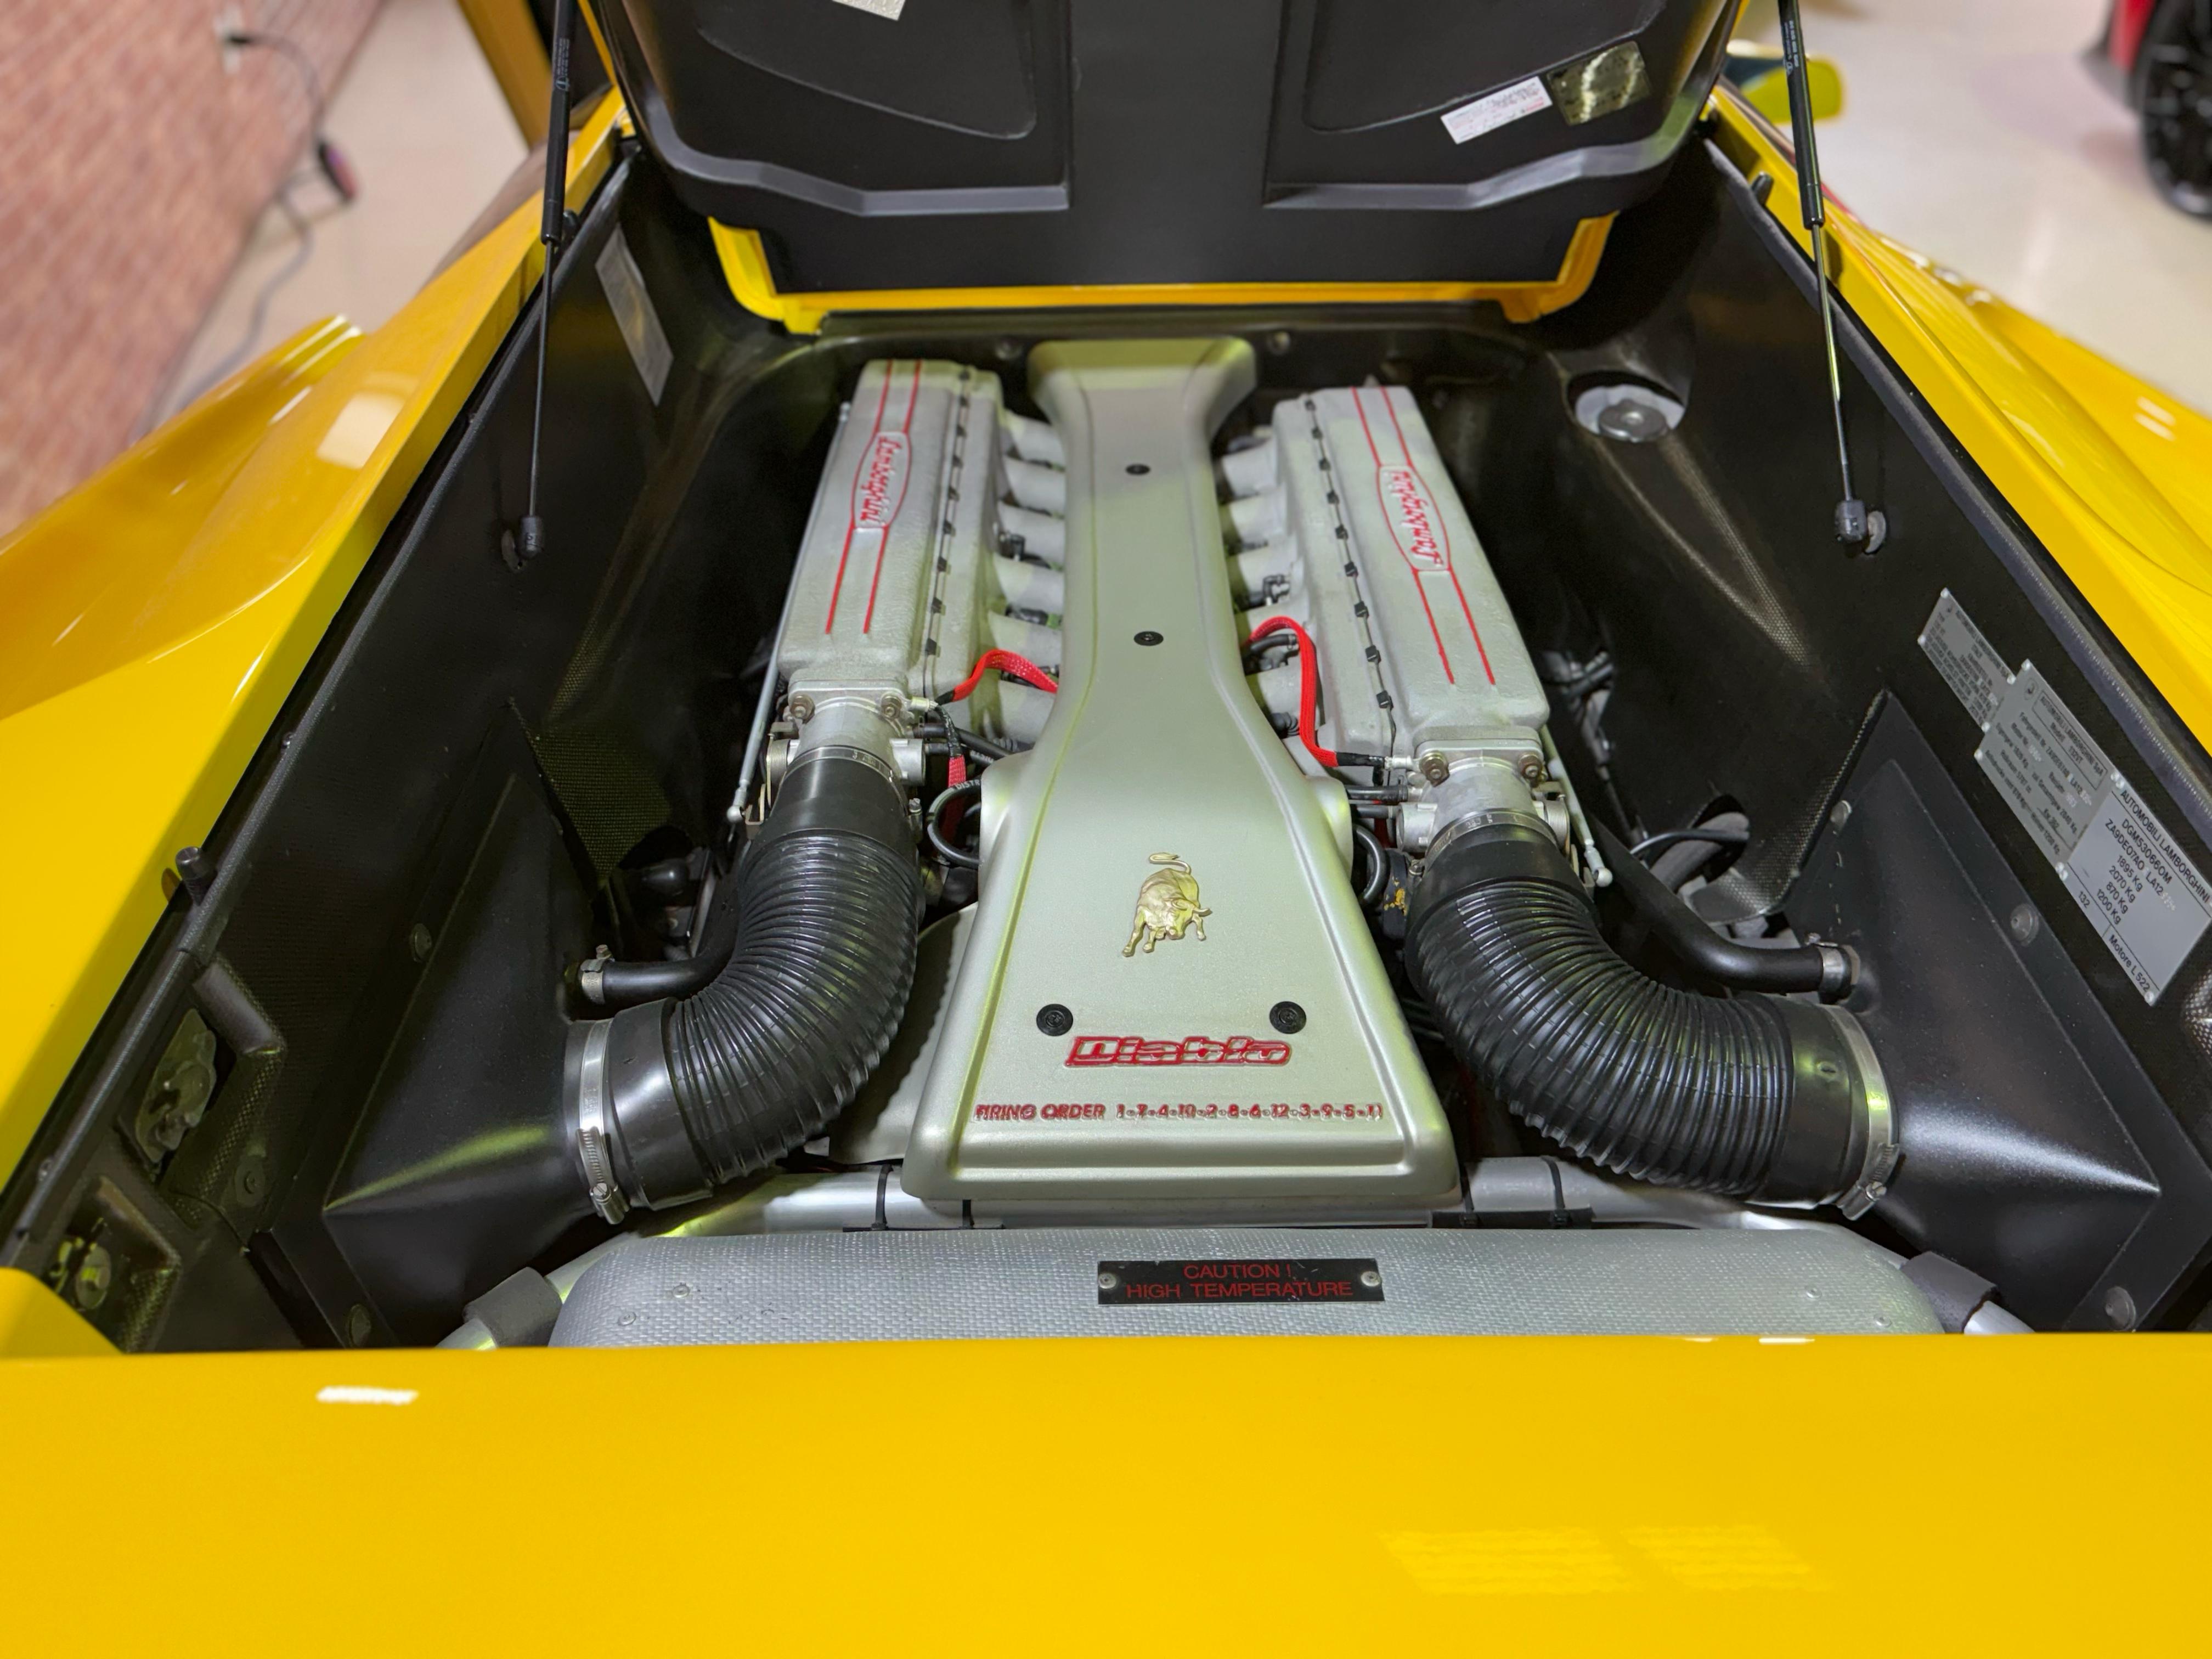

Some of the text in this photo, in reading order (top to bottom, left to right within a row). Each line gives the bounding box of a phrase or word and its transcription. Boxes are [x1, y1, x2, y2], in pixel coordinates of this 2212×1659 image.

[2119, 787, 2211, 904] AUTOMOBILI LAMBORGHINI
[2108, 864, 2137, 905] 2070 Kg
[2116, 853, 2145, 893] 1895 Kg
[2077, 889, 2091, 910] 132
[2095, 887, 2123, 927] 1200 Kg
[2105, 880, 2130, 916] 870 Kg
[2108, 933, 2133, 969] Motore
[2135, 970, 2151, 994] 522
[975, 1103, 1036, 1120] FIRING
[1041, 1103, 1105, 1120] ORDER
[1126, 1282, 1353, 1298] HIGH TEMPERATURE
[1183, 1263, 1280, 1279] CAUTION
